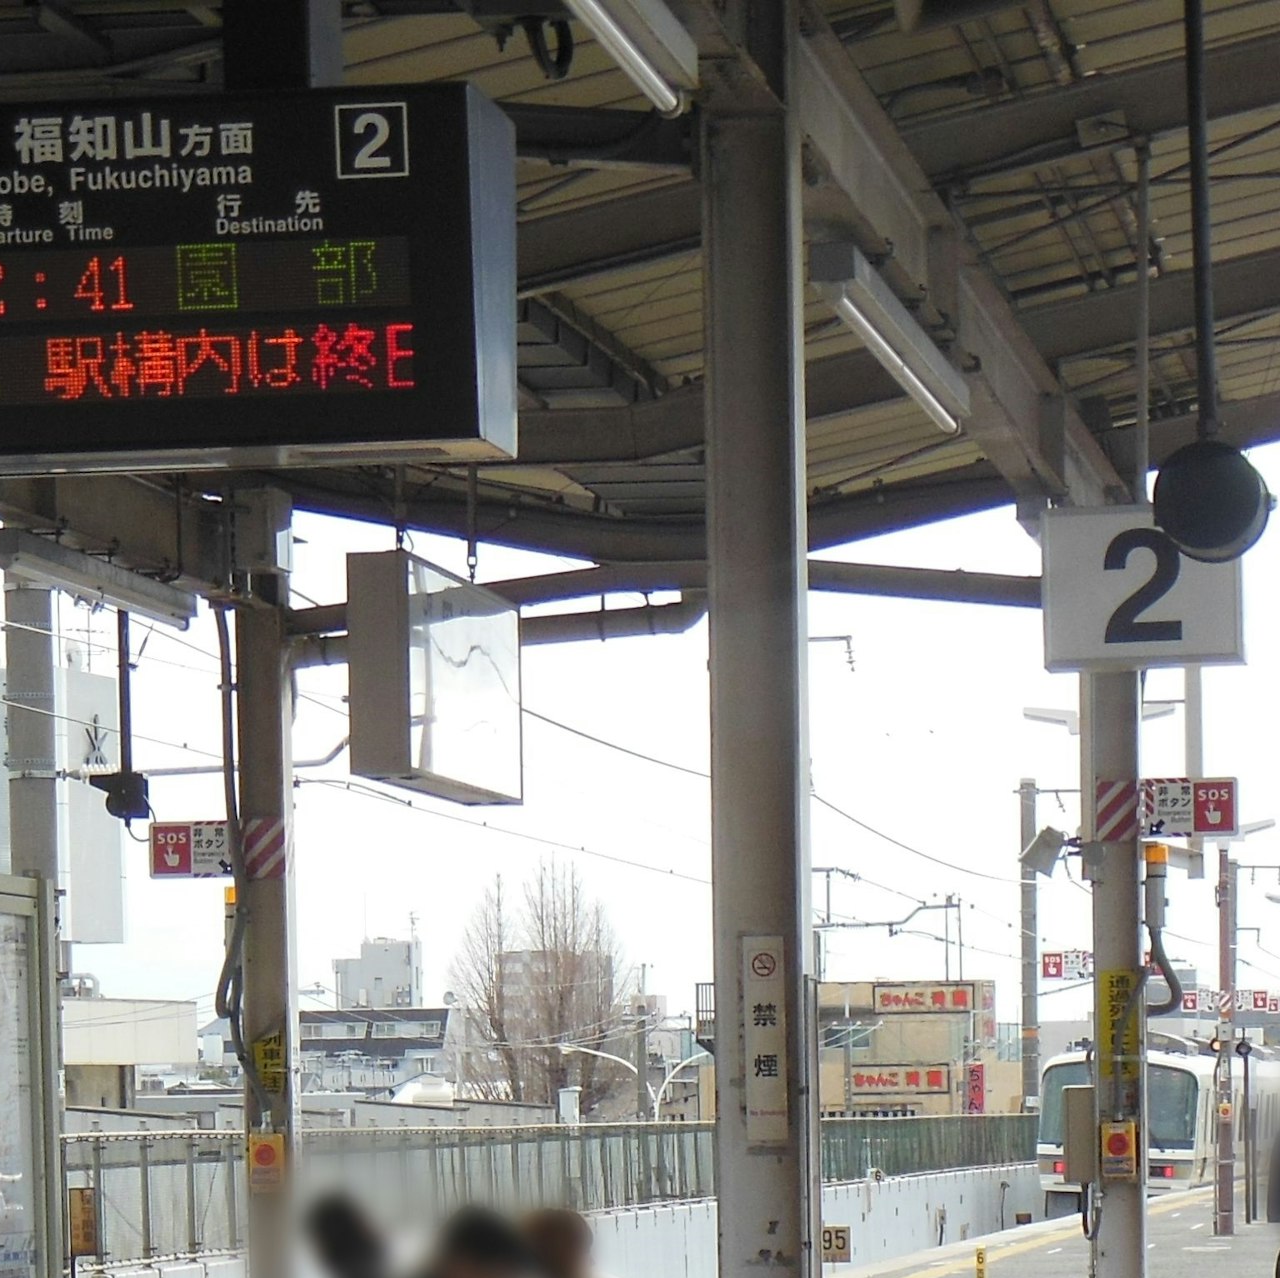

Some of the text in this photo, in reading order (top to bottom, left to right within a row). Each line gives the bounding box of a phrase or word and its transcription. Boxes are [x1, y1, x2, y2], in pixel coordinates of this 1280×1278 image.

[352, 112, 391, 169] 2
[69, 165, 253, 193] Fukuchiyama
[66, 223, 114, 243] Time
[216, 213, 323, 236] Destination
[1103, 527, 1182, 644] 2
[1198, 789, 1229, 801] SOS
[157, 832, 187, 844] SOS
[1044, 955, 1061, 964] SOS
[753, 1003, 778, 1077] 禁煙
[874, 1169, 882, 1181] 6
